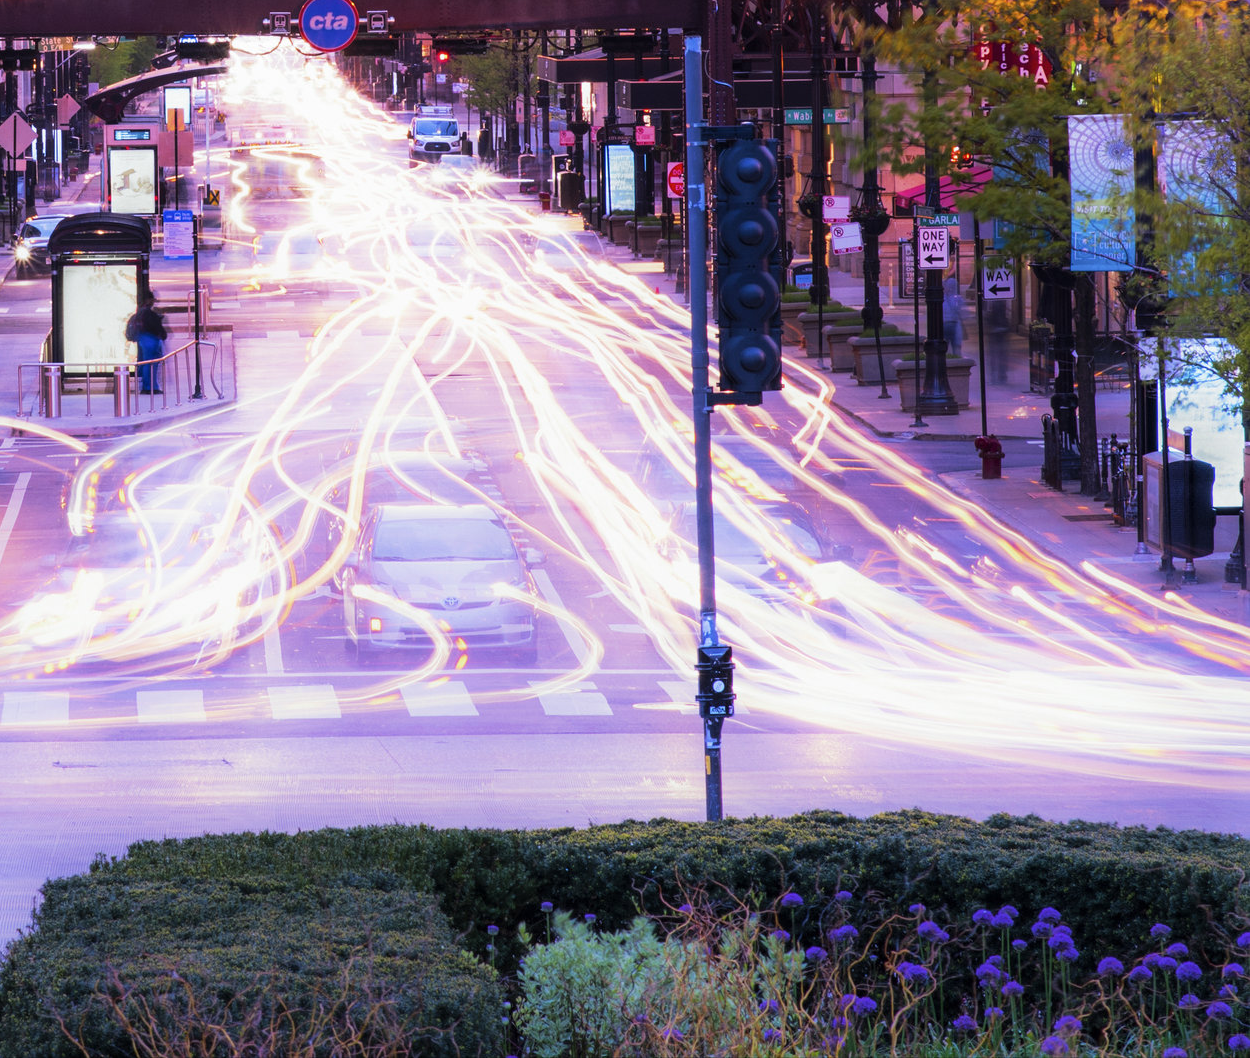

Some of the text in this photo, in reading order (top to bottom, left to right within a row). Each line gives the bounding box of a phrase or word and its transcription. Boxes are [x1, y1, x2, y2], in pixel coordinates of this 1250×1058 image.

[309, 11, 348, 31] cta
[41, 37, 62, 46] State
[923, 231, 945, 241] ONE
[922, 242, 945, 252] WAY
[986, 271, 1011, 282] WAY
